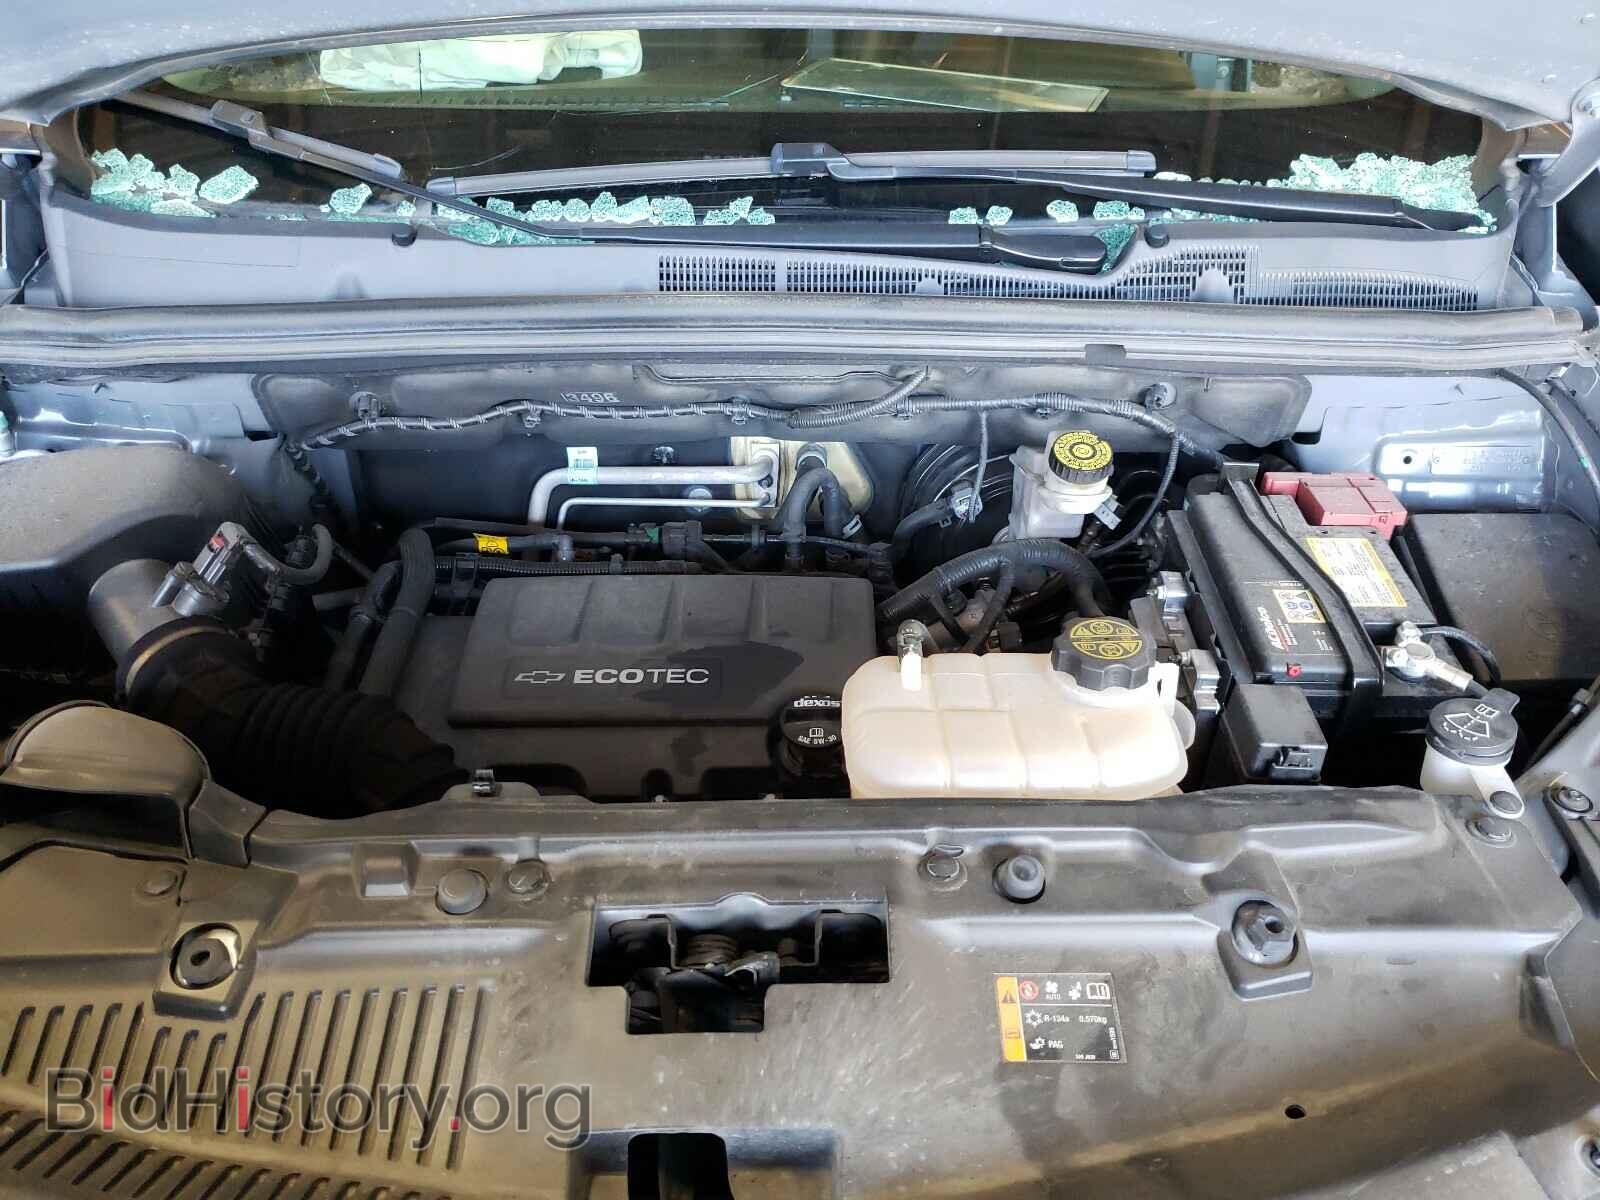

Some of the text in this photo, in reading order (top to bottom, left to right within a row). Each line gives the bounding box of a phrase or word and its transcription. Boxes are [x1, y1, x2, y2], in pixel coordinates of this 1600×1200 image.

[573, 668, 710, 684] ECOTEC
[793, 697, 841, 708] dexos
[1043, 1014, 1071, 1023] R-134a
